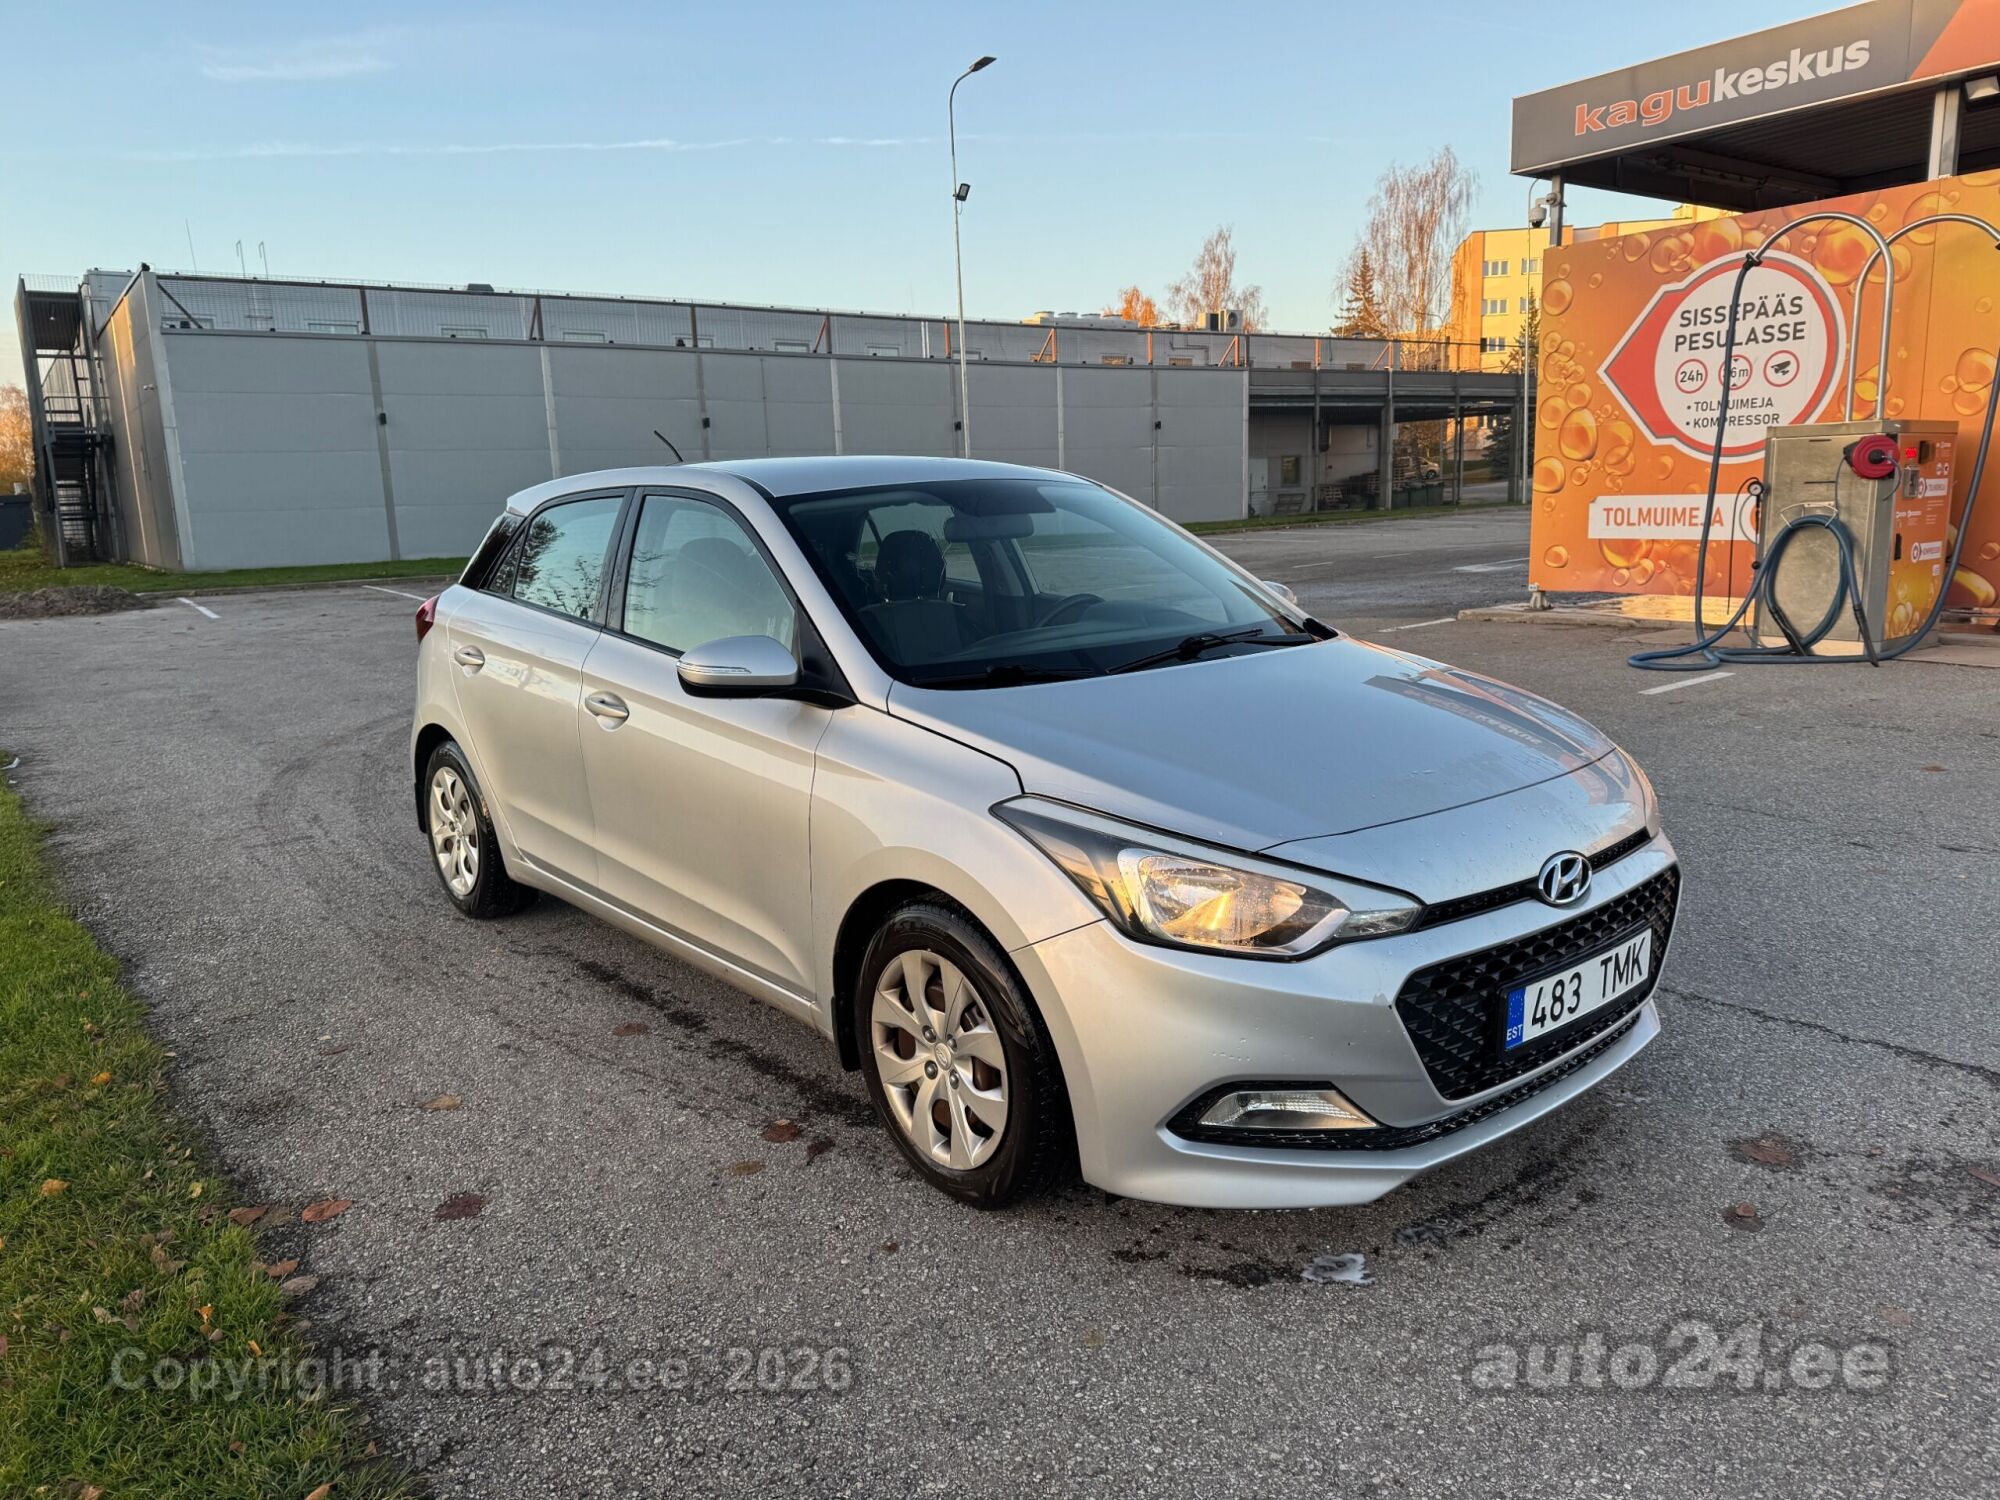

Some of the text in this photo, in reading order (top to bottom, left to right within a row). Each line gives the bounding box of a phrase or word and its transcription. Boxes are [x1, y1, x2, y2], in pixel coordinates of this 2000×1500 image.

[1574, 40, 1870, 136] kagukeskus
[1680, 370, 1703, 383] 24h
[1693, 413, 1780, 429] KOMRESSOR
[1603, 506, 1724, 527] TOLMUIMEA
[1531, 937, 1645, 1029] 483 TMK
[1506, 1024, 1523, 1041] EST
